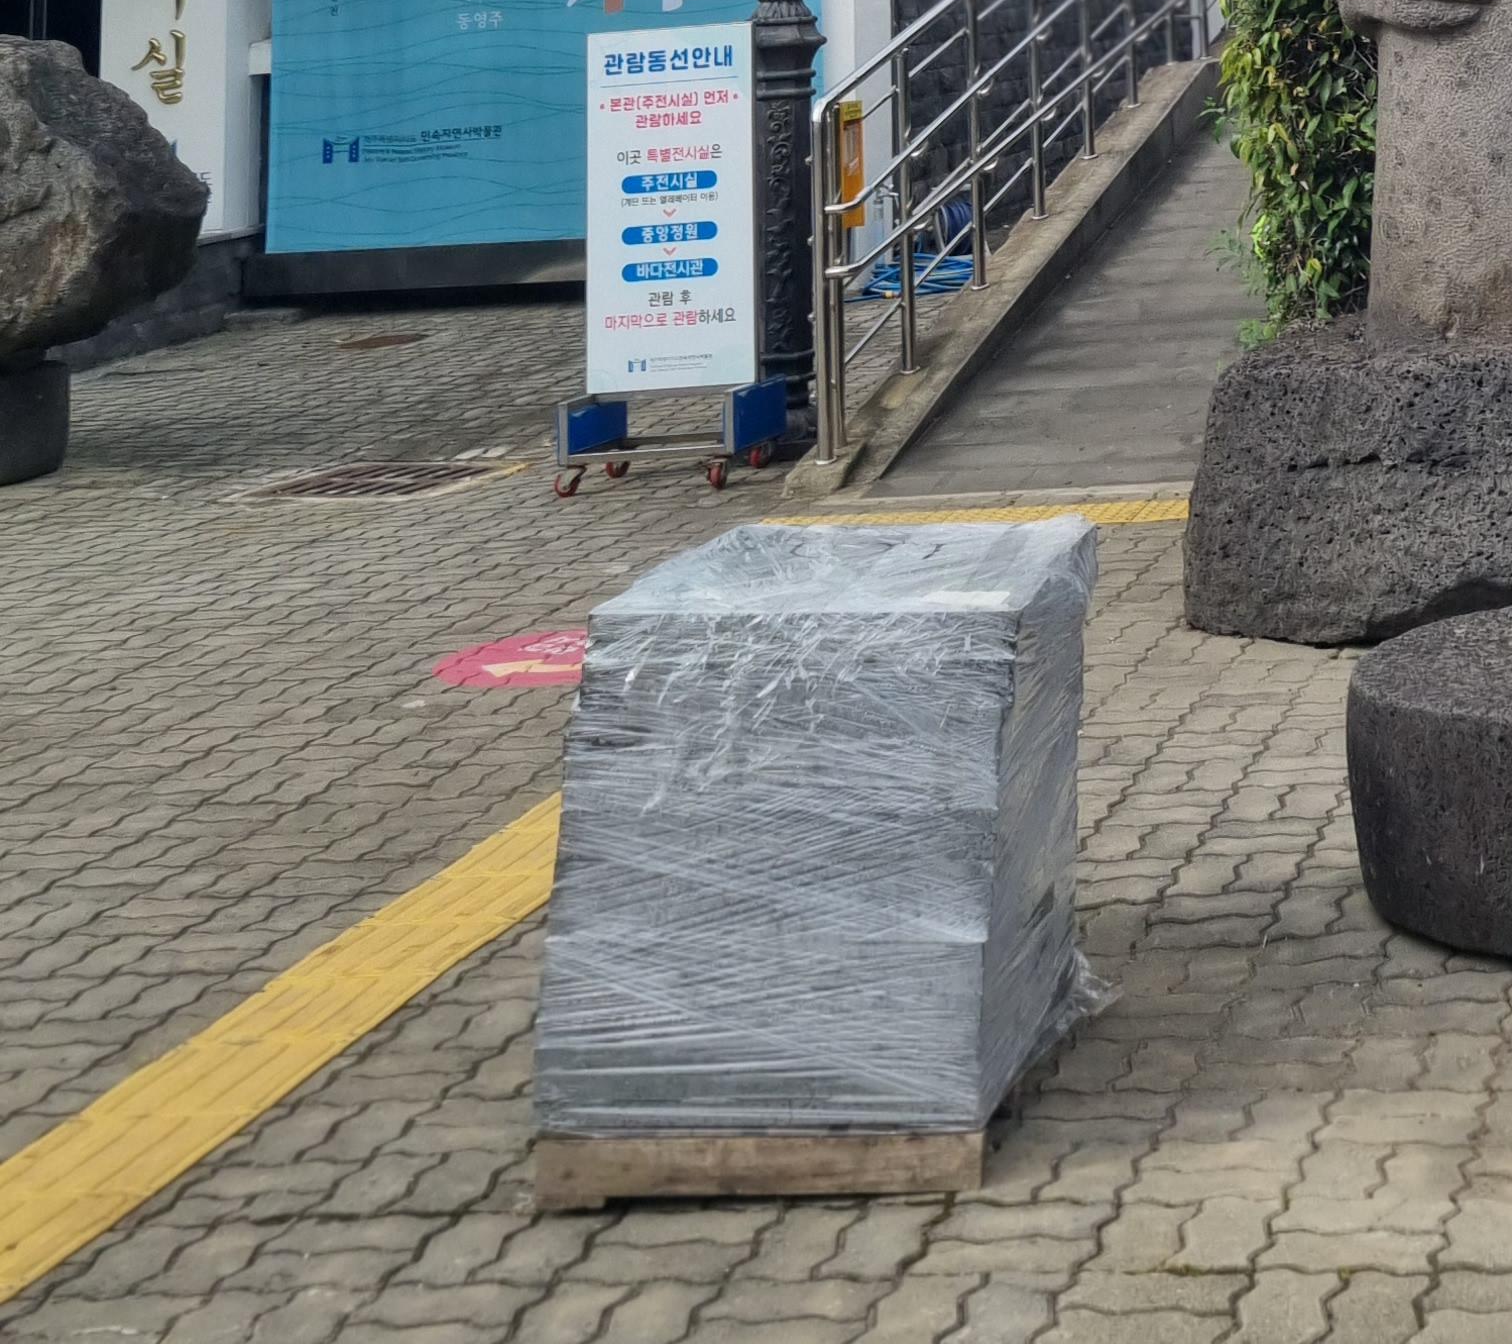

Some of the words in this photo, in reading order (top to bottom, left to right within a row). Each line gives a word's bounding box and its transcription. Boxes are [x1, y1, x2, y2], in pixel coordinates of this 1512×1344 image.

[603, 45, 733, 76] 관람동선안내
[610, 91, 698, 112] 본관(주전시실)
[704, 89, 729, 106] 먼저
[635, 110, 702, 129] 관람하세요
[616, 150, 642, 166] 이곳
[646, 143, 723, 163] 특별전시실은
[641, 172, 698, 192] 주전시실
[641, 223, 698, 243] 중앙정원
[636, 259, 704, 279] 바다전시관
[648, 290, 674, 307] 관람
[679, 289, 692, 305] 후
[604, 313, 668, 331] 마지막으로
[672, 307, 737, 326] 관람하세요
